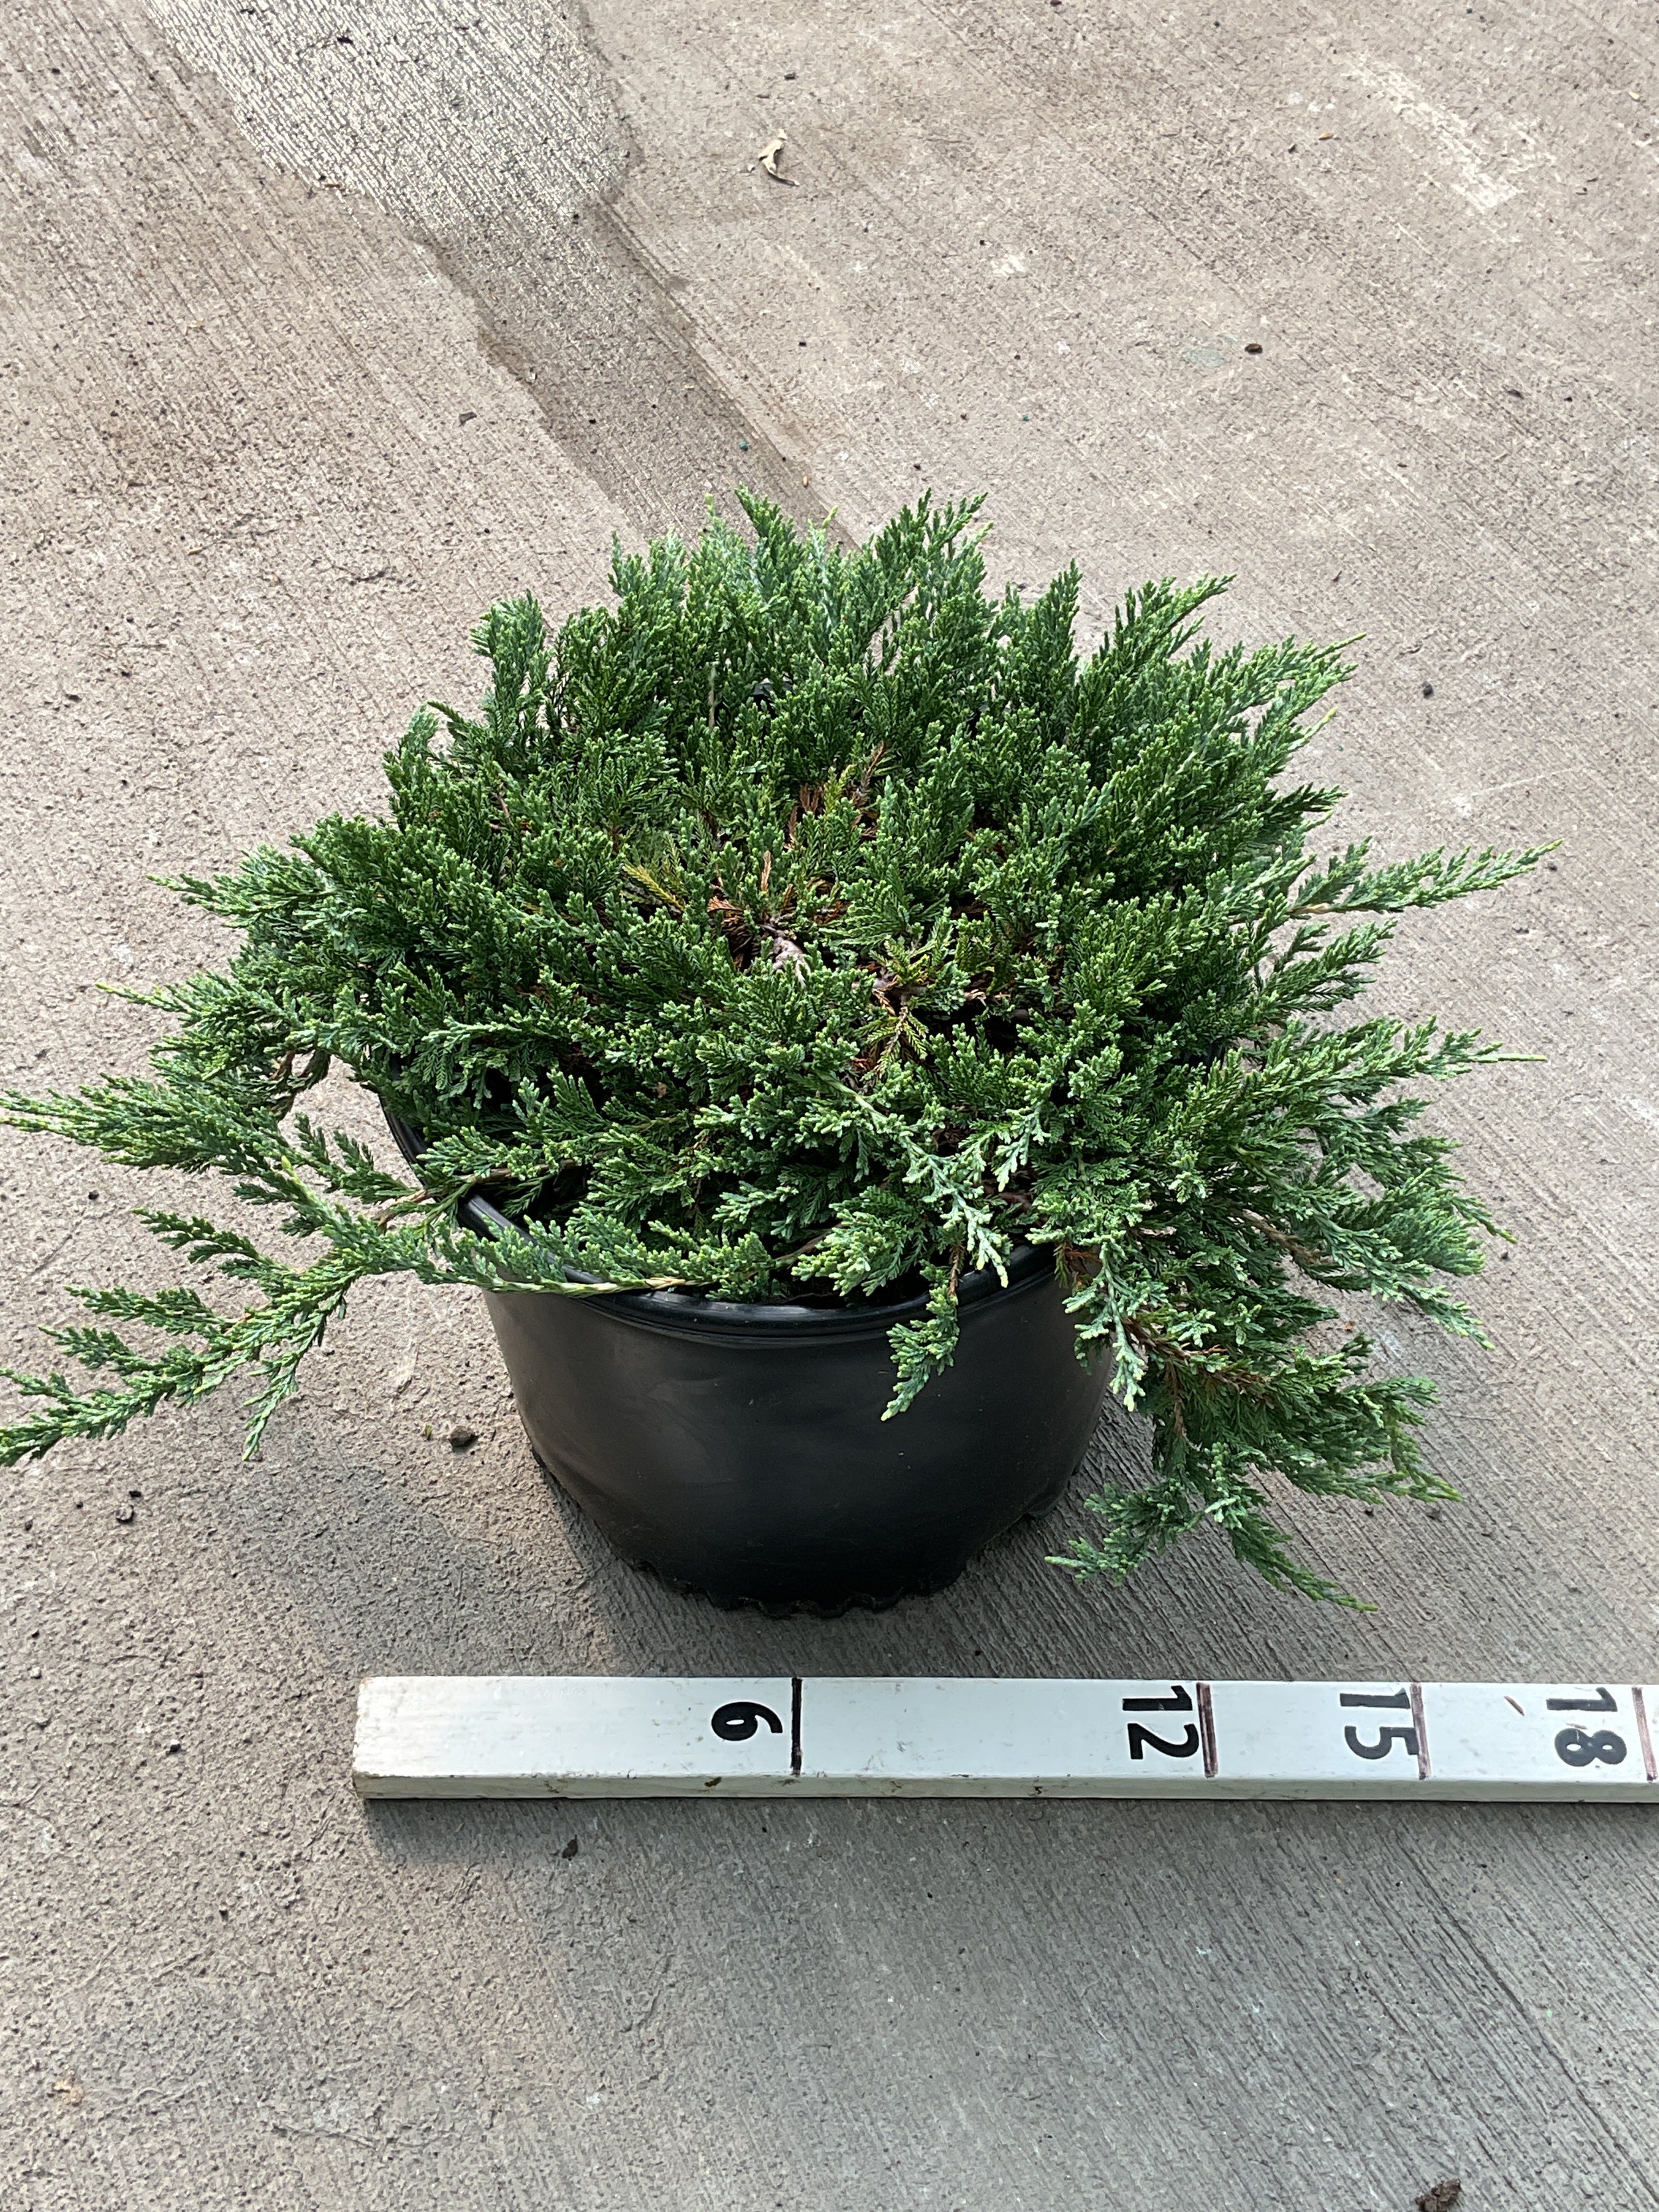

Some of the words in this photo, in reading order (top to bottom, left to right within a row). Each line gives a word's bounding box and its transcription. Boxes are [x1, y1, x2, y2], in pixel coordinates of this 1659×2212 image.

[711, 1701, 783, 1741] 6
[1122, 1685, 1200, 1760] 12
[1339, 1688, 1419, 1760] 15
[1546, 1686, 1627, 1767] 18
